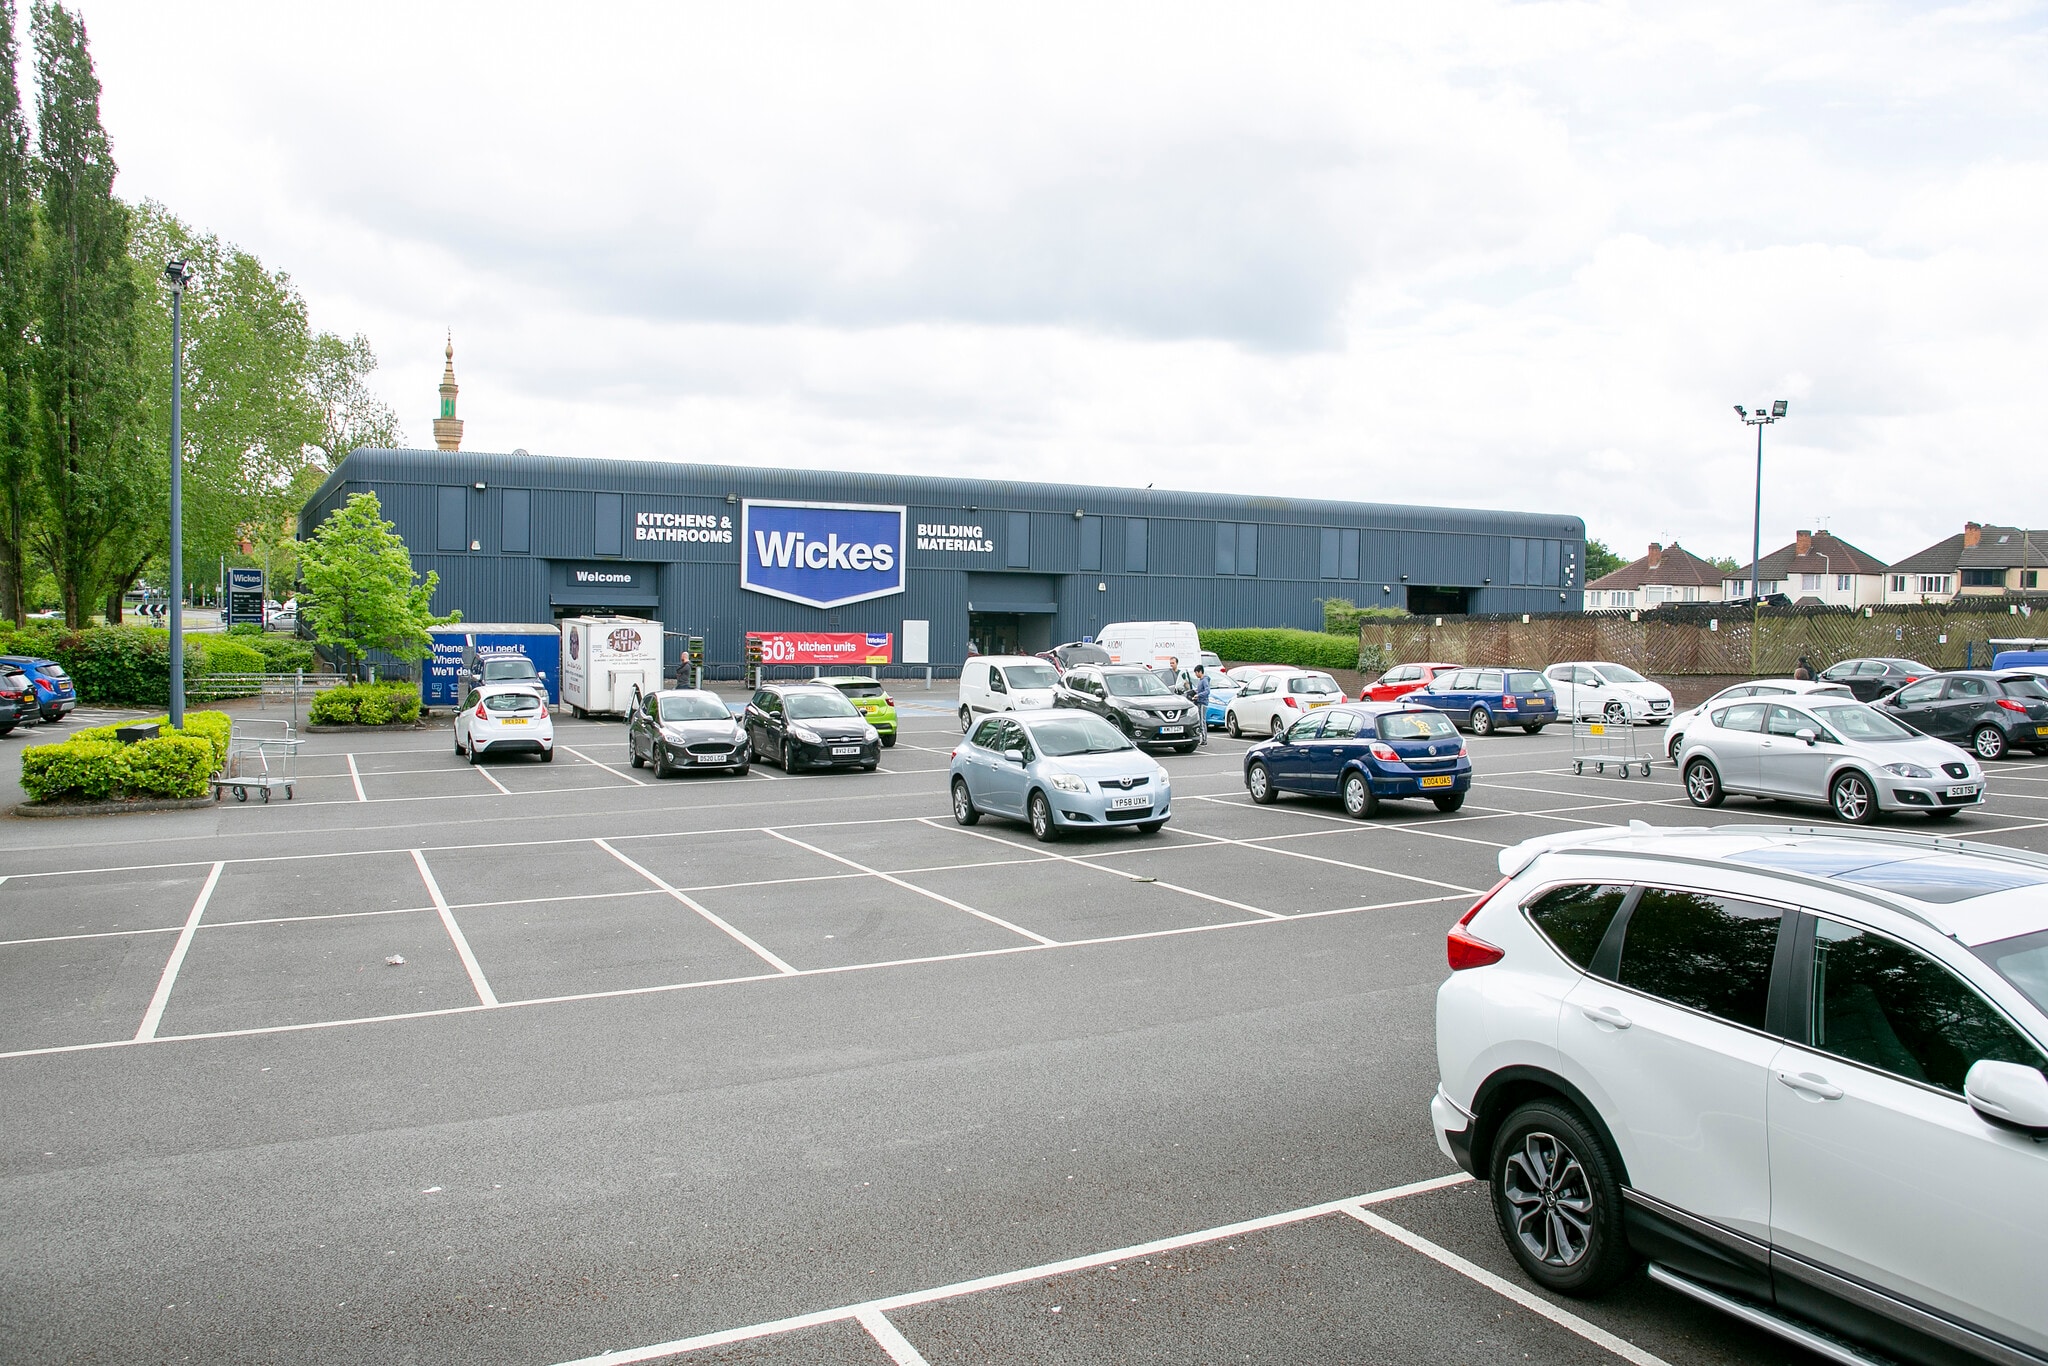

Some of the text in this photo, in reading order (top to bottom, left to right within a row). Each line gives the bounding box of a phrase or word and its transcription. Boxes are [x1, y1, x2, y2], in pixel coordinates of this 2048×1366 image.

[636, 512, 733, 529] KITCHENS &
[635, 528, 733, 543] BATHROOMS
[917, 523, 983, 538] BUILDING
[917, 538, 994, 552] MATERIALS
[754, 530, 894, 571] Wickes
[234, 574, 260, 583] Wickes
[576, 571, 632, 583] Welcome
[432, 644, 527, 654] Whene you need it.
[797, 641, 831, 652] kitchen
[833, 642, 857, 652] units
[1107, 641, 1123, 649] AXIOM
[1155, 641, 1176, 649] AXIOM
[432, 655, 464, 665] Wherev
[785, 653, 795, 661] off
[432, 667, 454, 676] We'll
[1439, 775, 1451, 784] UAS
[1114, 797, 1147, 807] YP58 UXH
